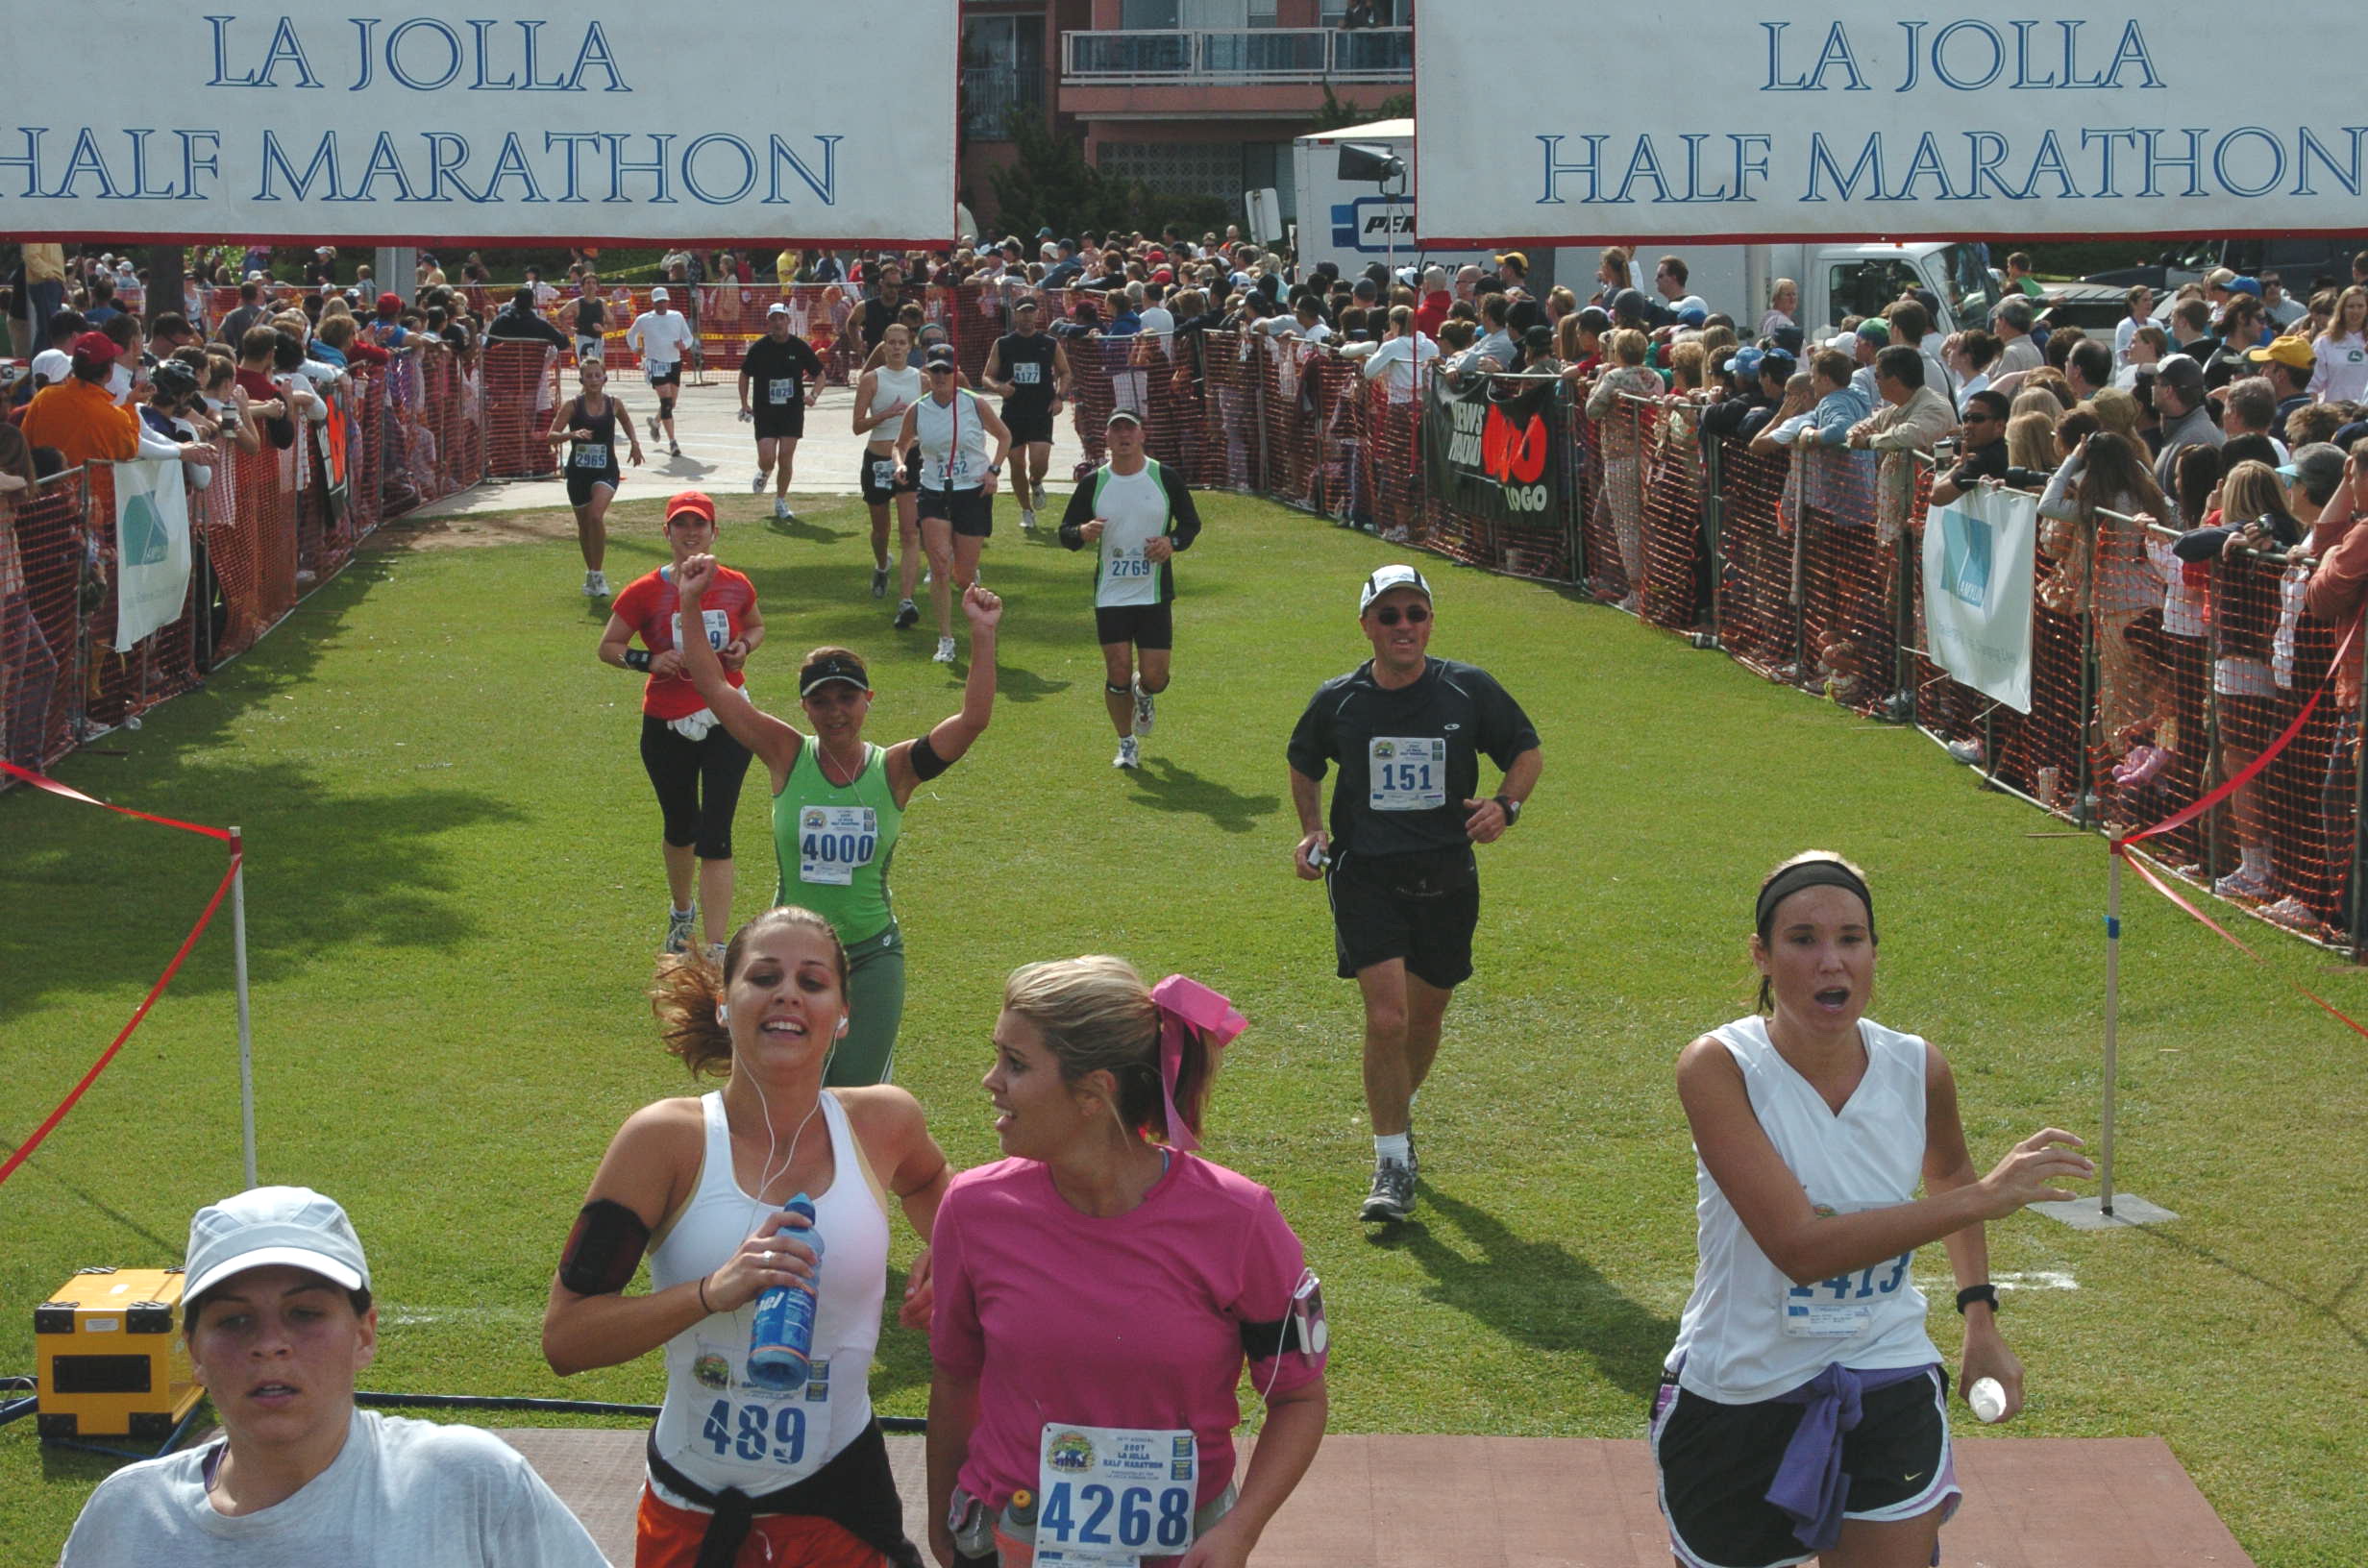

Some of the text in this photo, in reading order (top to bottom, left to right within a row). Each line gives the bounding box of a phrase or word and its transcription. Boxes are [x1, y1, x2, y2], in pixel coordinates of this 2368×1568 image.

[204, 15, 633, 92] LA JOLLA
[1759, 19, 2168, 92] LA JOLLA
[252, 130, 844, 207] MARATHON
[1536, 127, 2368, 205] HALF MARATHON
[1112, 560, 1150, 576] 2769
[1382, 763, 1432, 791] 151
[802, 833, 875, 863] 4000
[1789, 1252, 1911, 1300] 413
[703, 1398, 806, 1464] 489
[1040, 1482, 1190, 1547] 4268
